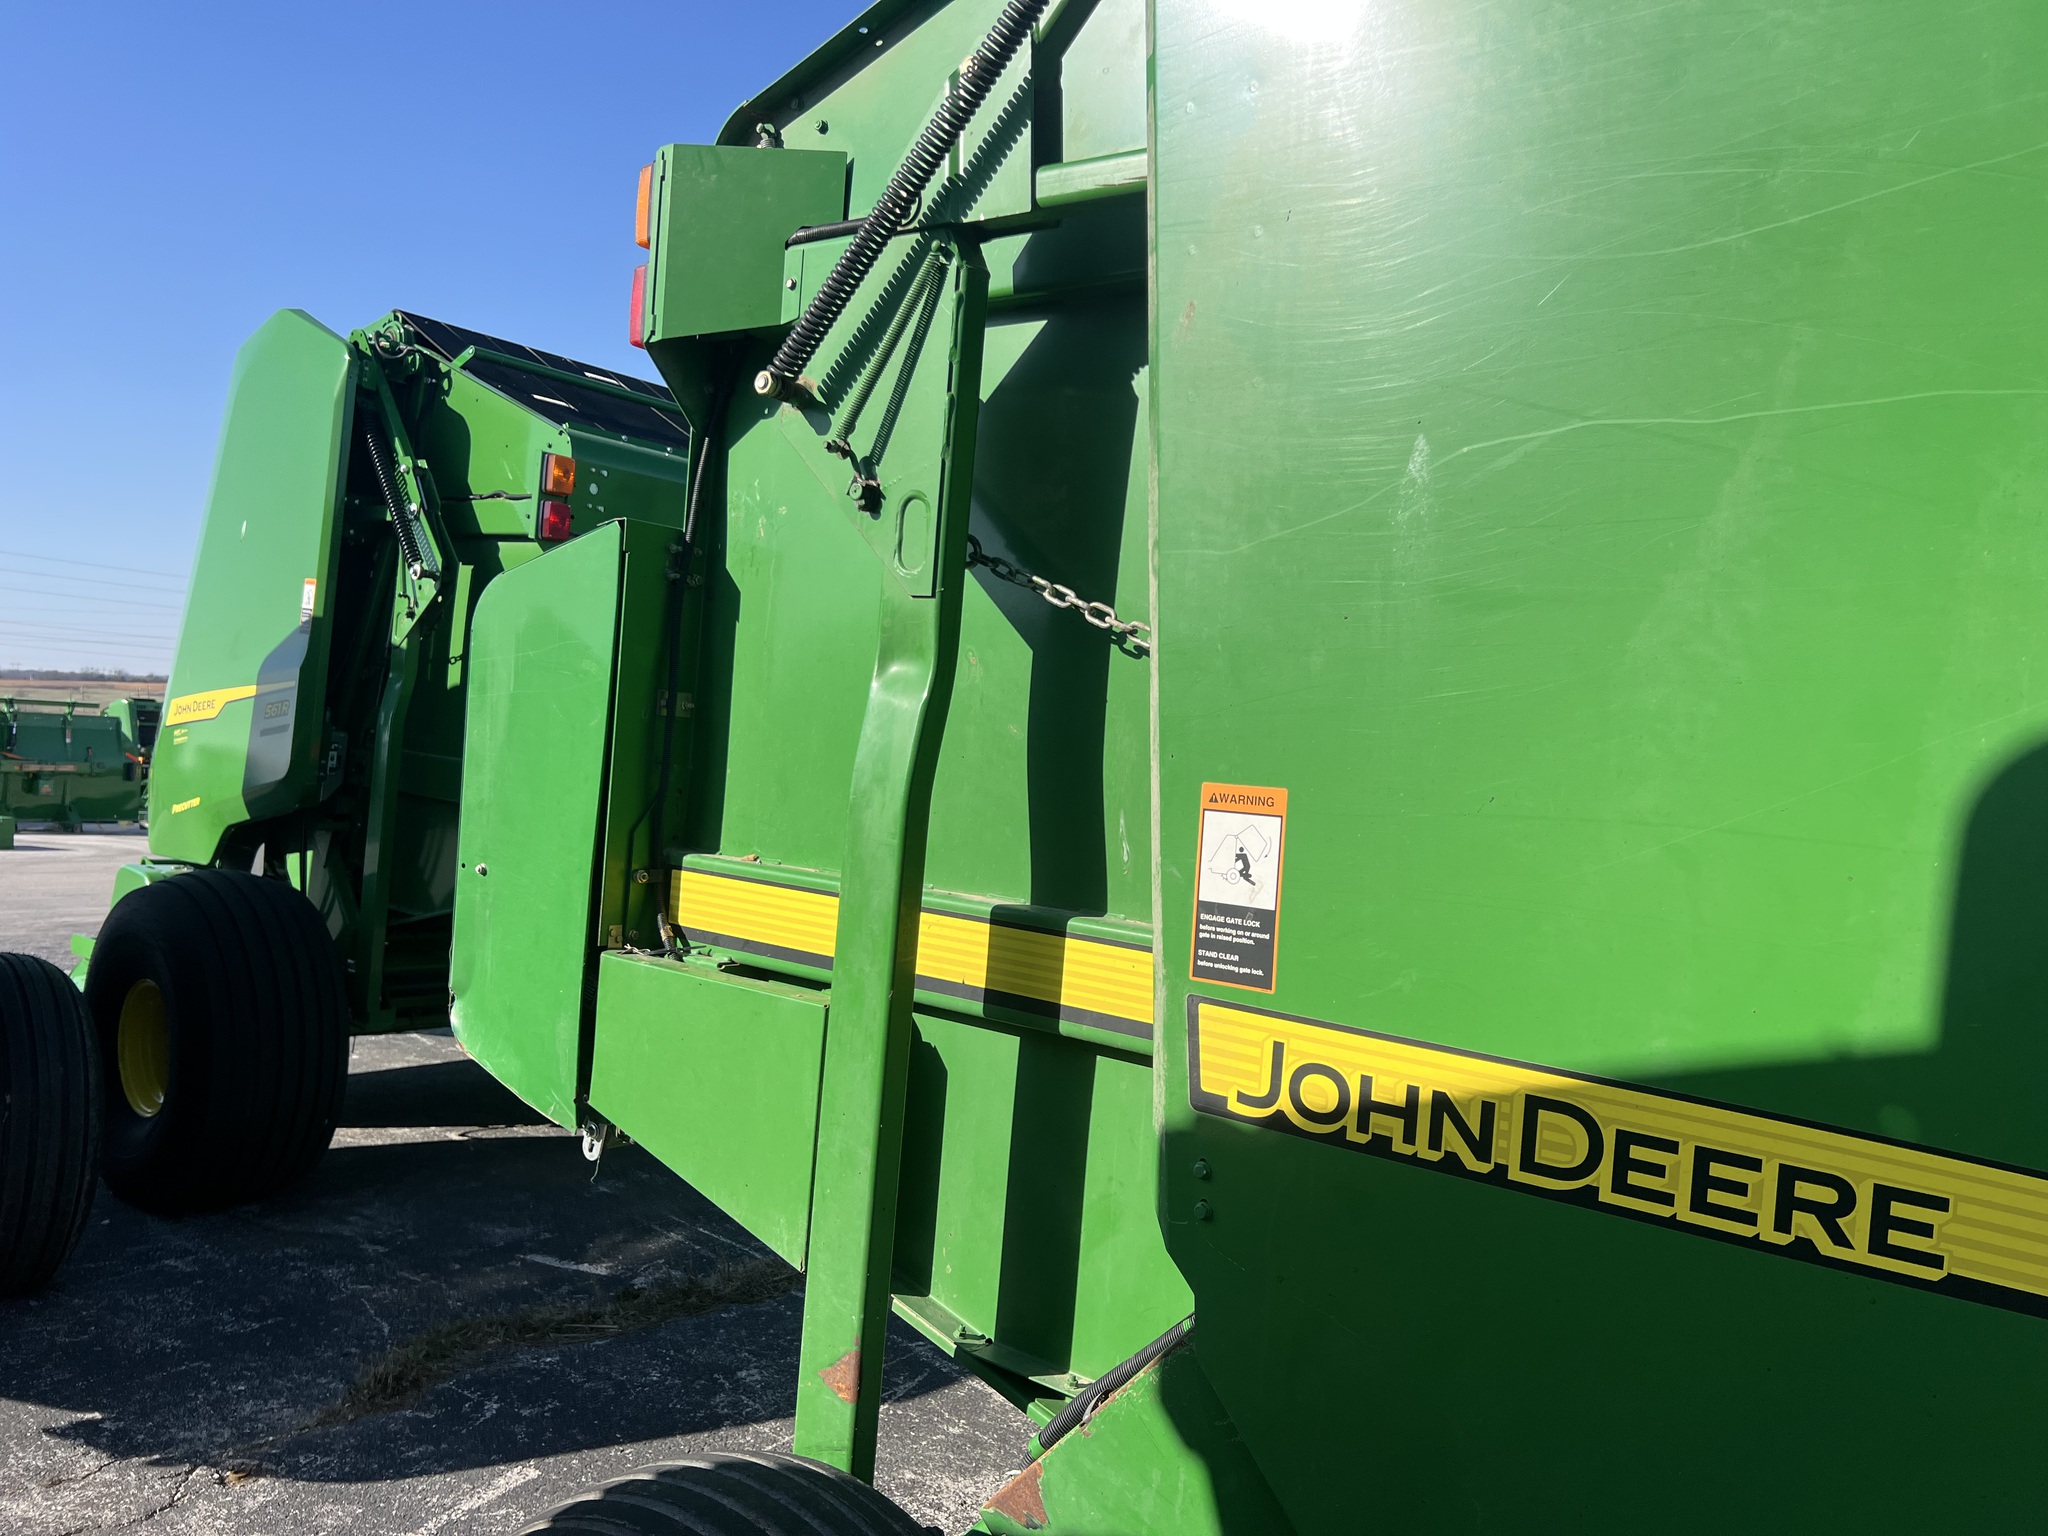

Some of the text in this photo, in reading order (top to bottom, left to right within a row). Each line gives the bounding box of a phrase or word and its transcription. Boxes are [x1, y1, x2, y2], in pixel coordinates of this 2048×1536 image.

[174, 699, 216, 716] JOHN DEERE
[264, 700, 290, 718] 561R
[1219, 793, 1275, 807] WARNING
[1200, 913, 1260, 928] ENGAGE GATE LOCK
[1216, 926, 1236, 936] working
[1216, 934, 1232, 942] raised
[1233, 937, 1255, 945] position.
[1198, 949, 1239, 961] STAND CLEAR
[1197, 959, 1213, 967] before
[1214, 962, 1238, 973] unlocking
[1251, 968, 1264, 976] lock.
[1233, 1040, 1953, 1277] JOHN DEERE
